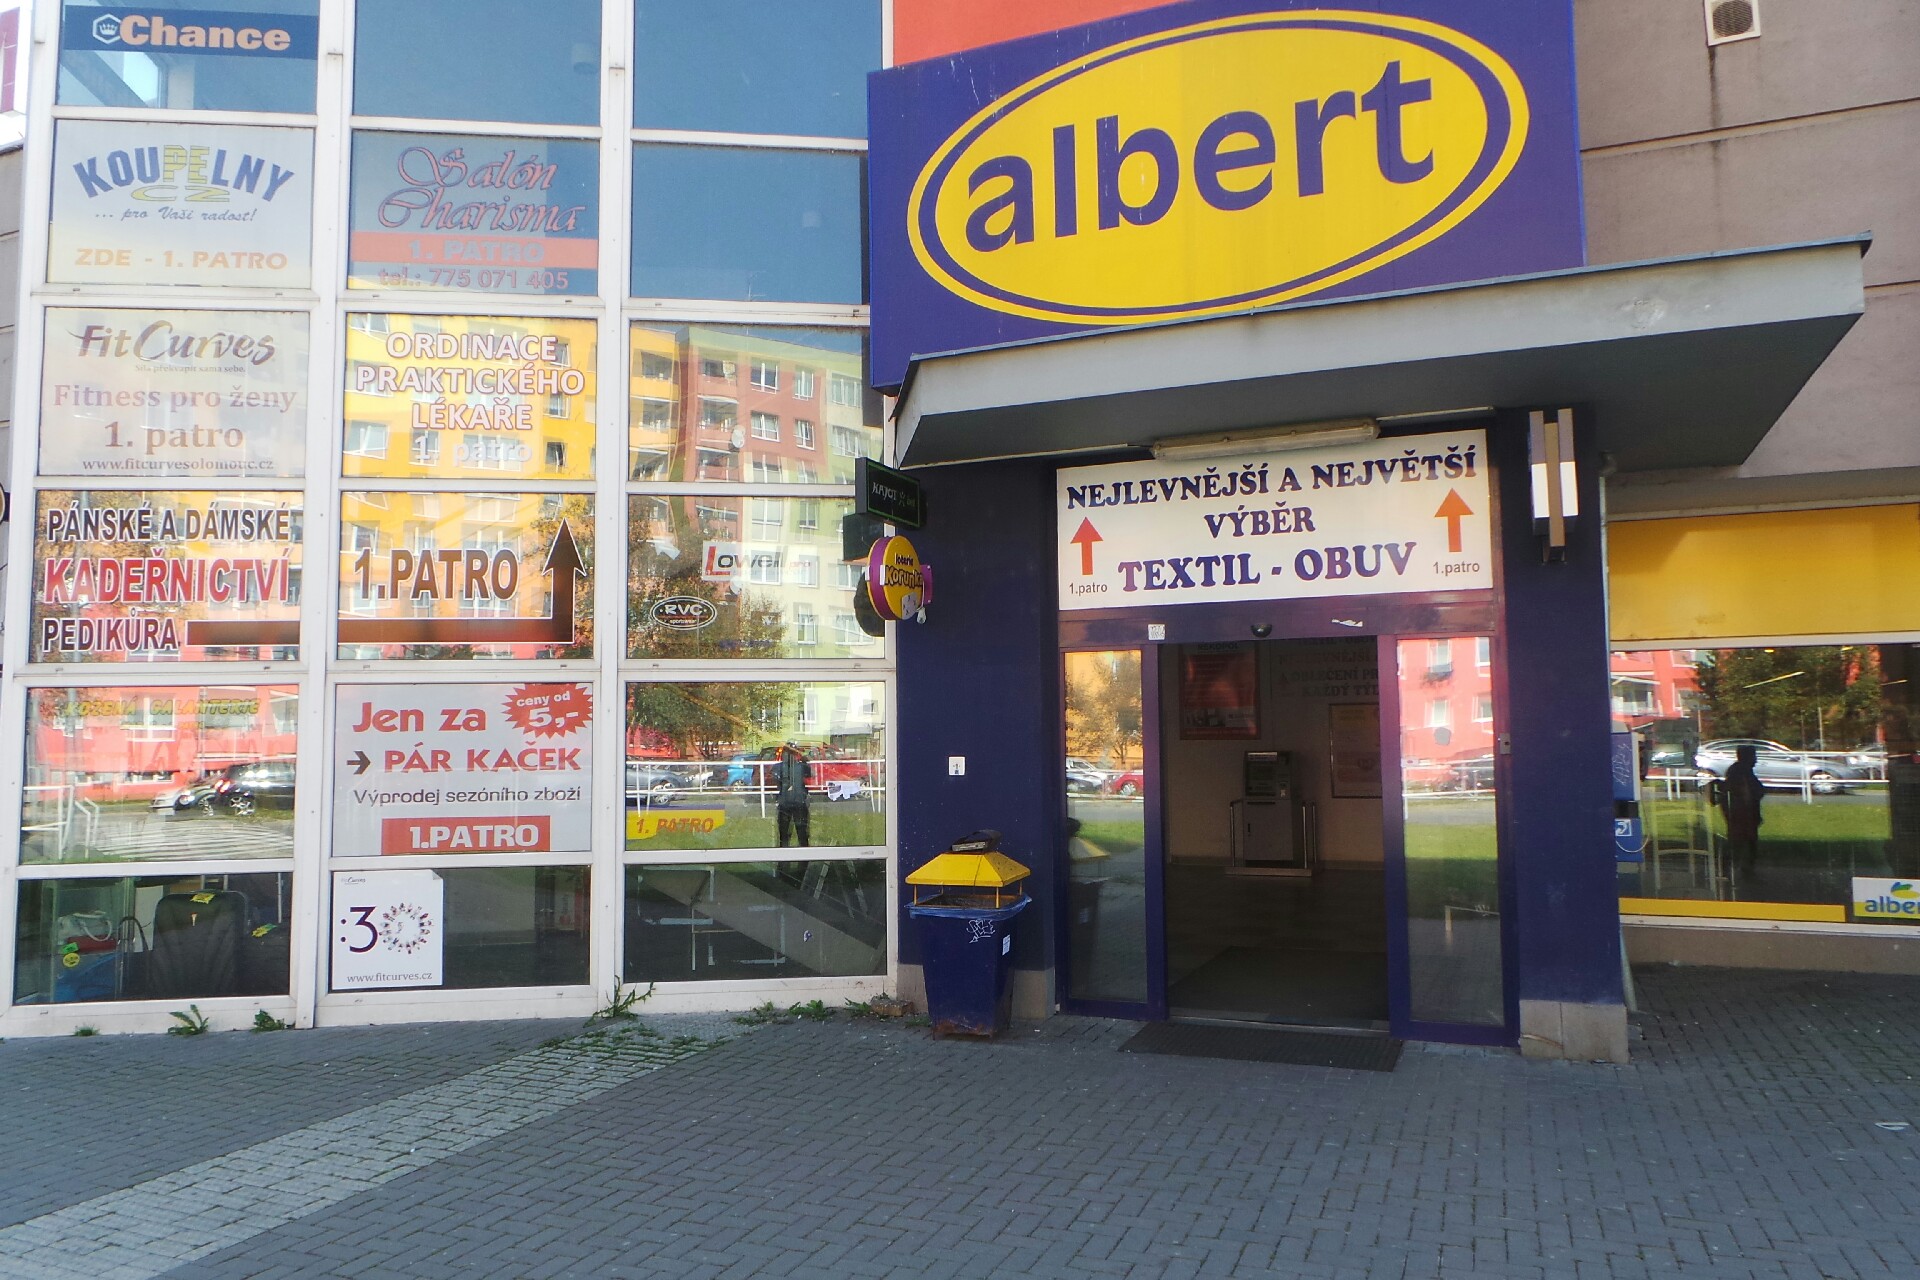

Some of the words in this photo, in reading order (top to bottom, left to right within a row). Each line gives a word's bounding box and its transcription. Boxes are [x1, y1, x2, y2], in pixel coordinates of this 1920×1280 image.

[120, 15, 291, 50] Chance
[398, 147, 558, 190] Salón
[964, 59, 1434, 253] albert
[73, 145, 294, 201] KOUPELNY
[130, 185, 230, 202] CZ
[121, 208, 148, 221] pro
[157, 206, 193, 220] Vaši
[201, 208, 257, 222] radost!
[378, 187, 586, 232] Charisma
[74, 248, 132, 266] ZDE
[162, 251, 184, 267] 1.
[192, 251, 288, 270] PATRO
[408, 240, 432, 260] 1.
[443, 240, 545, 262] PATRO
[378, 267, 421, 286] tel.:
[429, 268, 471, 287] 775
[478, 270, 517, 288] 071
[527, 271, 569, 289] 405
[386, 332, 558, 361] ORDINACE
[356, 363, 585, 395] PRAKTICKÉHO
[54, 385, 161, 407] Fitness
[169, 391, 221, 412] pro
[229, 385, 297, 413] ženy
[412, 397, 533, 430] LÉKAŘE
[104, 421, 133, 448] 1.
[145, 424, 243, 455] patro
[452, 438, 532, 467] patro
[83, 458, 274, 470] www.fitcurvesolomouc.cz
[1067, 463, 1268, 509] NEJLEVNĚJŠÍ
[1278, 467, 1302, 492] A
[1311, 445, 1477, 489] NEJVĚTŠÍ
[47, 500, 151, 542] PÁNSKÉ
[159, 509, 177, 542] A
[184, 501, 290, 542] DÁMSKÉ
[1204, 501, 1315, 538] VÝBĚR
[354, 547, 519, 600] 1.PATRO
[705, 546, 788, 575] Lowell
[1118, 553, 1260, 592] TEXTIL
[1294, 542, 1417, 581] OBUV
[1432, 561, 1480, 576] 1.patro
[43, 547, 290, 604] KADEŘNICTVÍ
[1069, 582, 1108, 596] 1.patro
[664, 604, 703, 615] RVC
[43, 607, 179, 652] PEDIKŮRA
[62, 695, 138, 716] KOŽENÁ
[150, 698, 262, 715] GALANTERIE
[516, 694, 549, 707] ceny
[554, 691, 571, 702] od
[353, 702, 424, 732] Jen
[438, 708, 486, 732] za
[529, 707, 578, 728] 5,-
[384, 741, 452, 773] PÁR
[467, 741, 581, 772] KAČEK
[353, 789, 440, 807] Výprodej
[445, 787, 528, 802] sezóního
[534, 786, 581, 801] zboží
[410, 824, 539, 849] 1.PATRO
[636, 818, 650, 834] 1.
[656, 817, 714, 833] PATRO
[347, 973, 432, 983] www.fitcurves.cz
